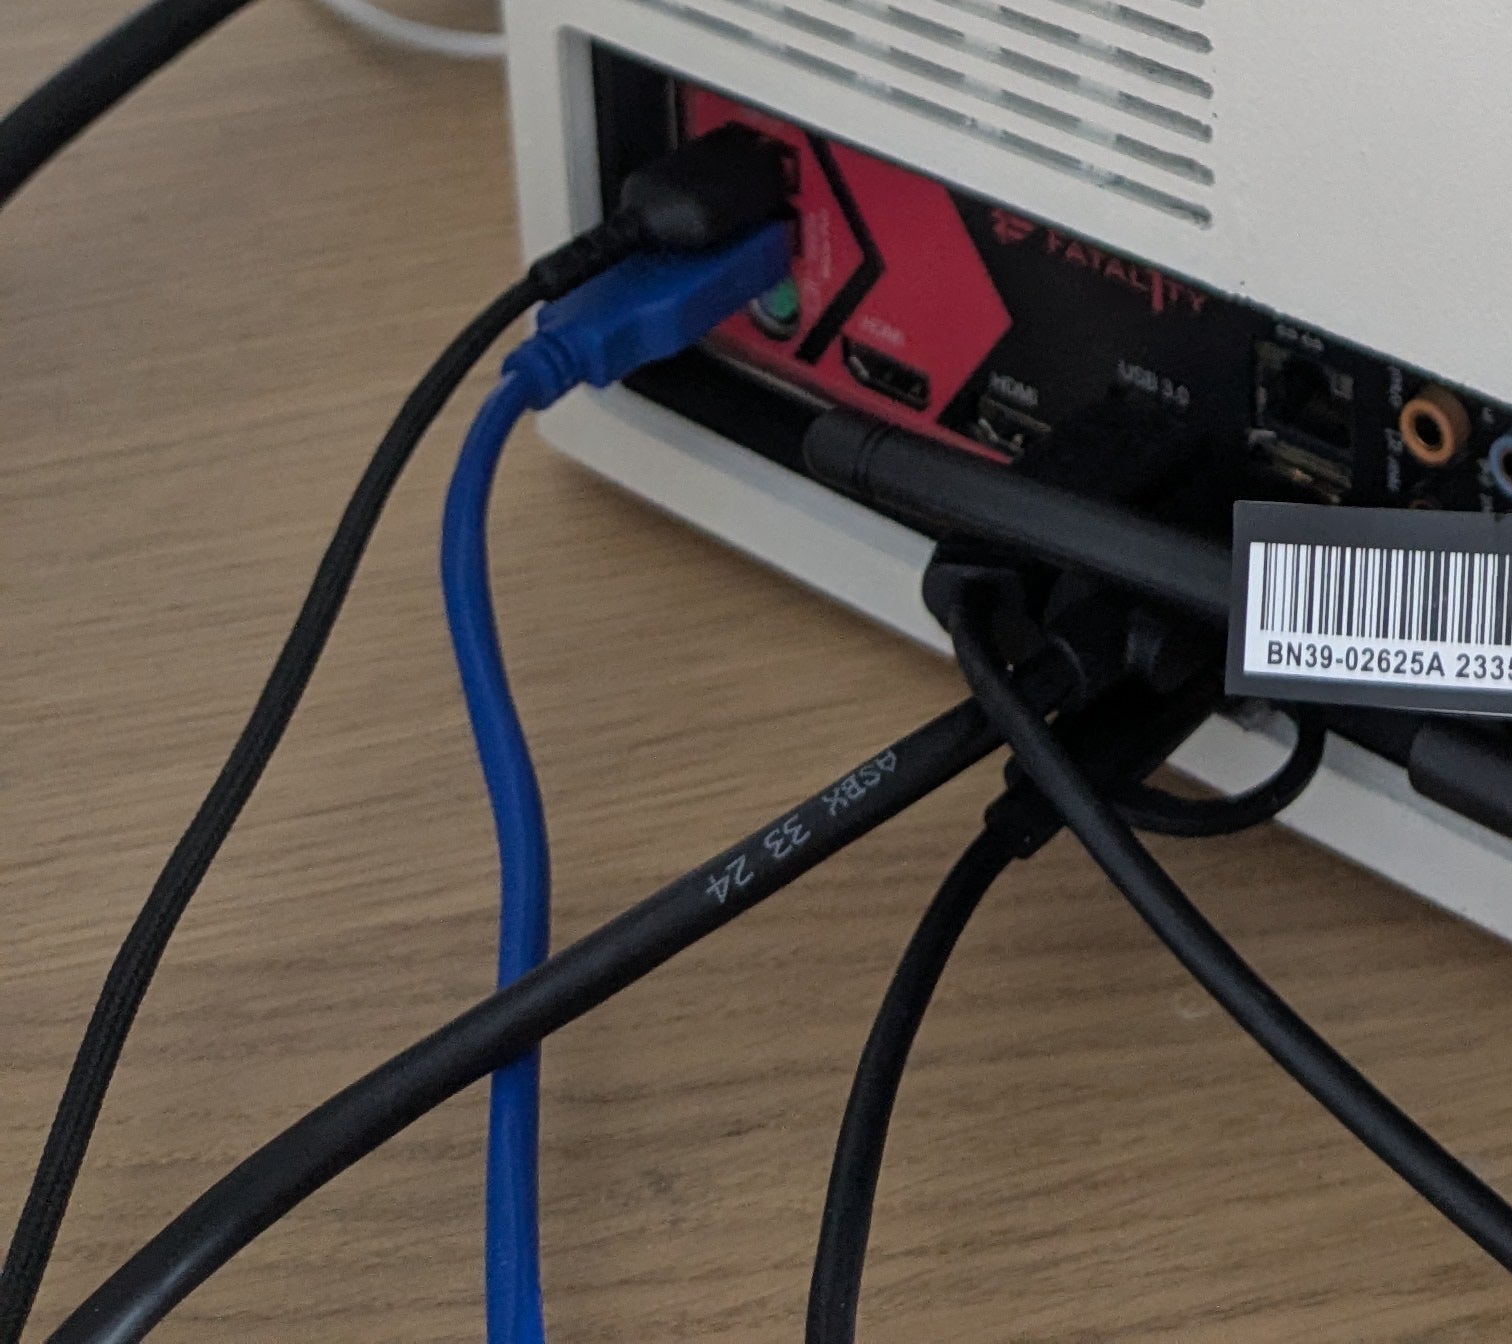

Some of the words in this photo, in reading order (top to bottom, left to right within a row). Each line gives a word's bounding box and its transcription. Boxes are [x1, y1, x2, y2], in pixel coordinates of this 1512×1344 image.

[1266, 639, 1446, 678] BN39-02625A
[763, 813, 812, 859] 33
[704, 853, 755, 905] 24
